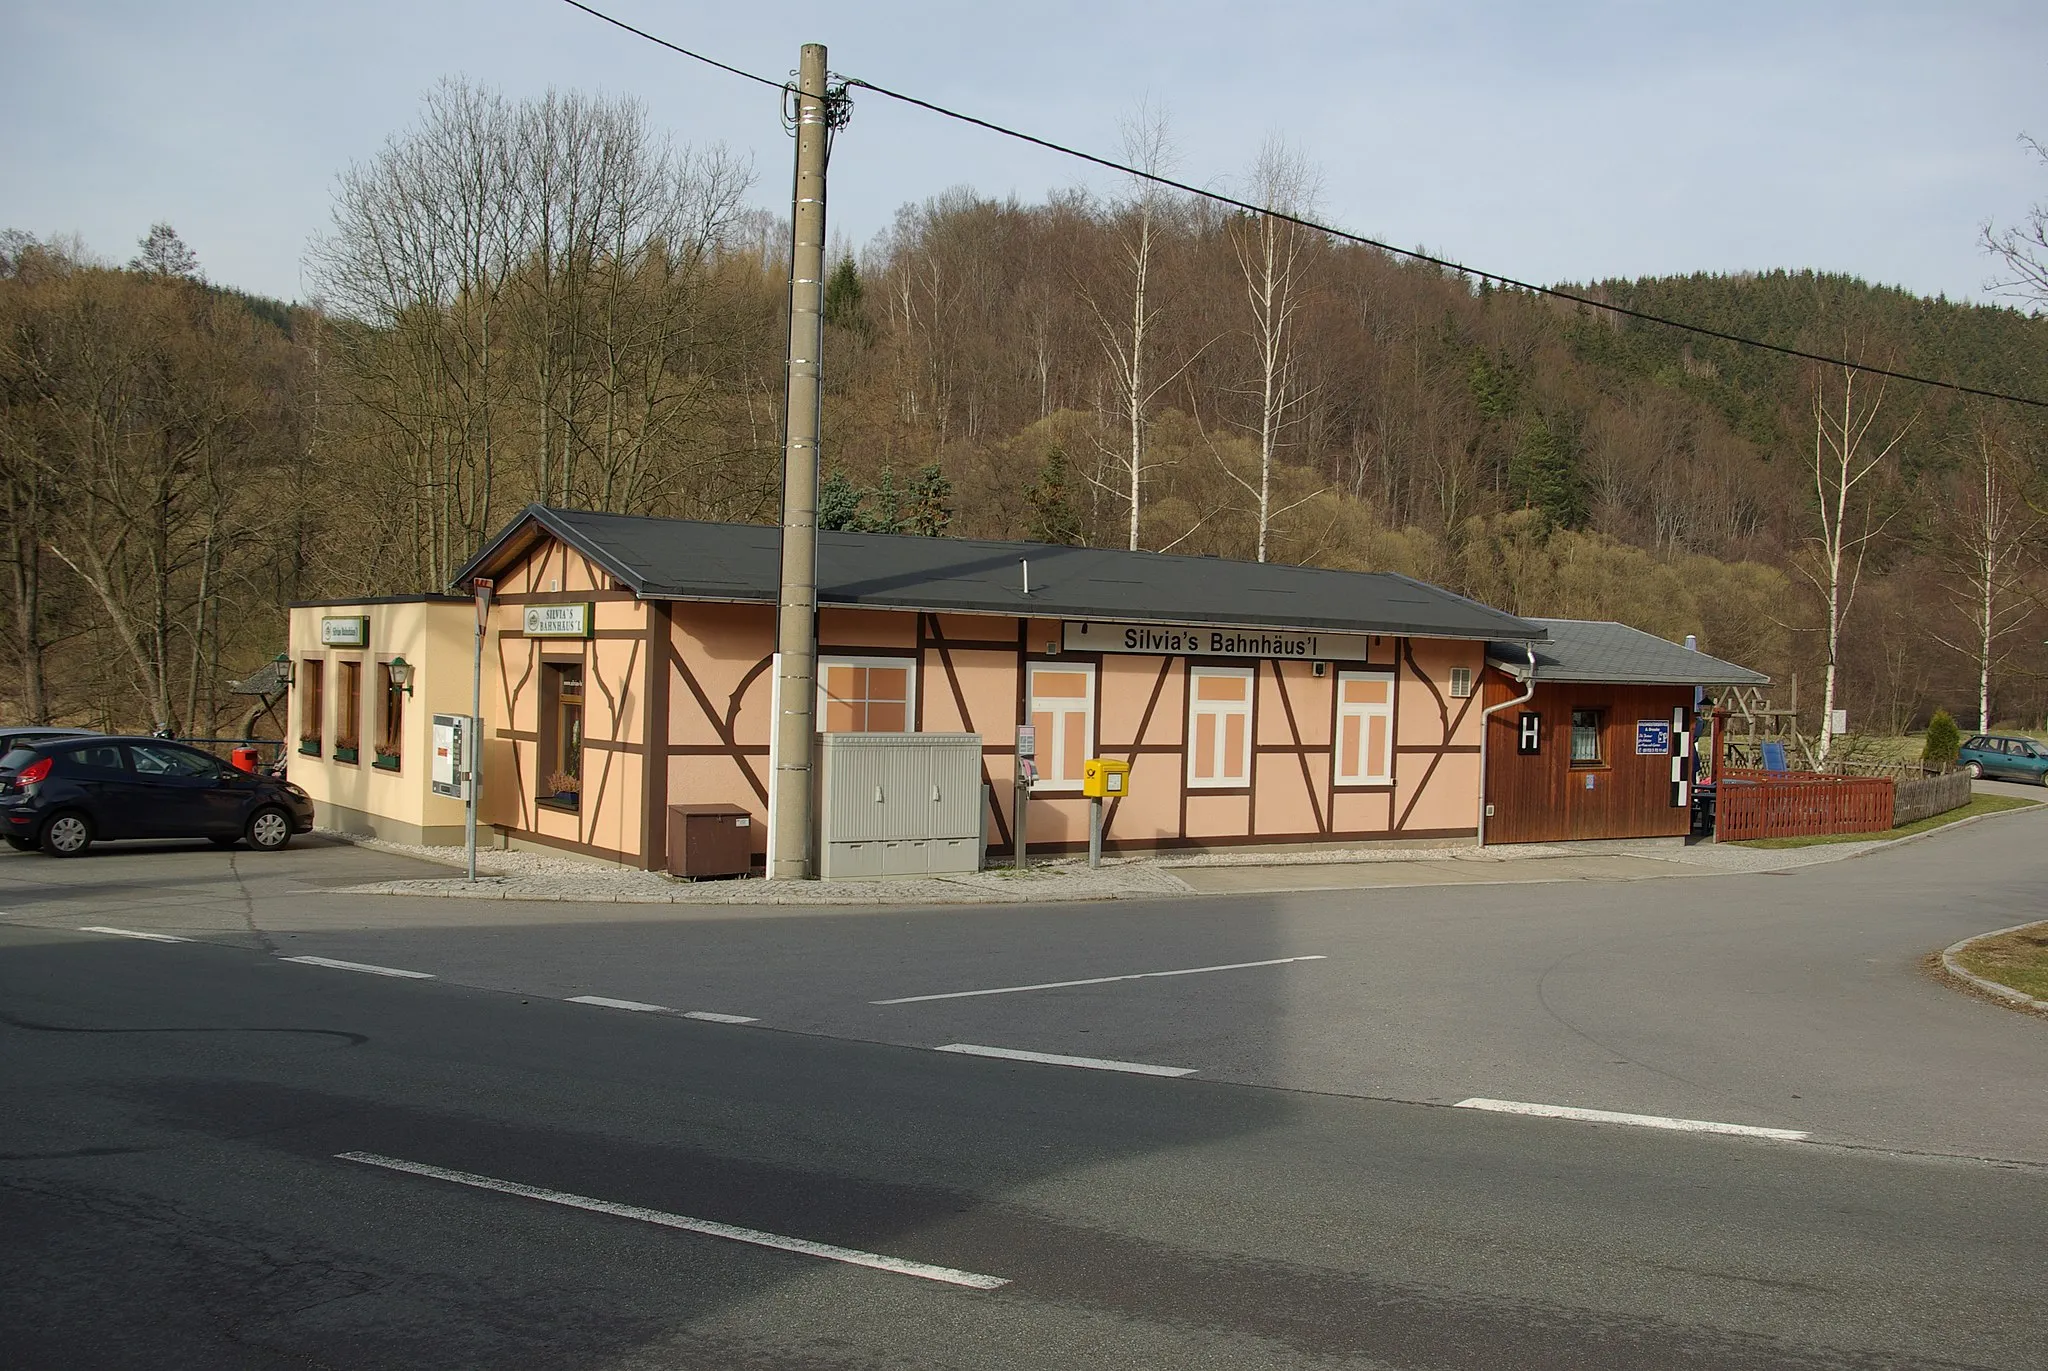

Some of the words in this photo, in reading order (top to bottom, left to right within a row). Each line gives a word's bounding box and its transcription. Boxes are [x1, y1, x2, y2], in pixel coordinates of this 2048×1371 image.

[1124, 628, 1199, 651] Silvia's
[1210, 632, 1317, 656] Bahnhäus'l
[1521, 716, 1539, 749] H
